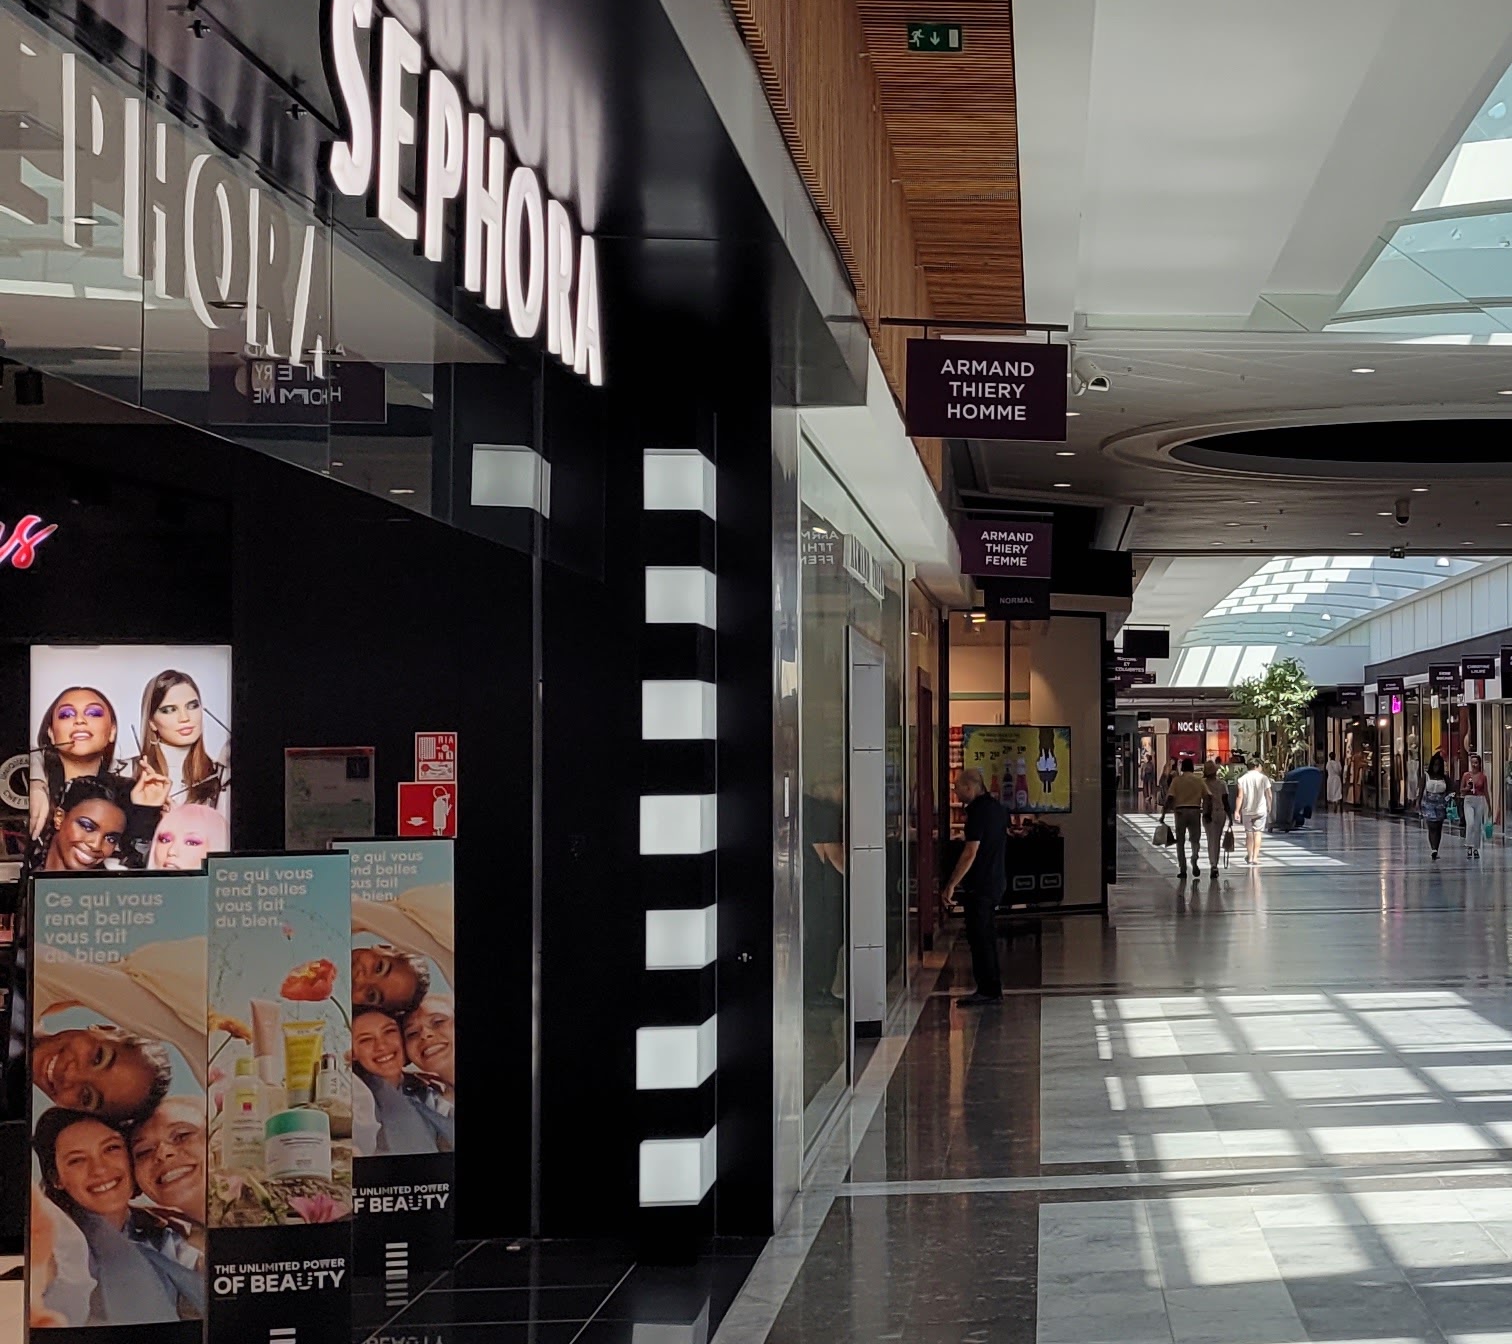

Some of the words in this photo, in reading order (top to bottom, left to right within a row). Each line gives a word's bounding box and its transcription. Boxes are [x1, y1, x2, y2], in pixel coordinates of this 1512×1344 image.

[940, 359, 1035, 377] ARMAND
[949, 381, 1026, 399] THIERY
[947, 403, 1027, 421] HOMME
[980, 531, 1035, 543] ARMAND
[985, 543, 1029, 555] THIERY
[985, 556, 1028, 567] FEMME
[999, 597, 1035, 605] NORMAL
[364, 850, 386, 864] qui
[391, 850, 424, 862] vous
[215, 868, 239, 883] Ce
[243, 867, 269, 885] qui
[275, 867, 314, 881] vous
[375, 862, 418, 876] belles
[215, 882, 251, 897] rend
[257, 881, 308, 896] belles
[376, 875, 399, 889] fait
[44, 892, 73, 908] Ce
[79, 891, 111, 910] qui
[116, 893, 164, 907] vous
[215, 898, 252, 913] vous
[257, 896, 286, 912] fait
[44, 909, 89, 927] rend
[95, 908, 156, 926] belles
[215, 913, 237, 929] du
[242, 913, 282, 928] bien.
[44, 930, 90, 946] vous
[95, 927, 128, 945] fait
[360, 1185, 412, 1196] UNLIMITED
[413, 1183, 450, 1194] POWER
[369, 1193, 450, 1213] BEAUTY
[214, 1264, 237, 1275] THE
[239, 1261, 301, 1274] UNLIMITED
[303, 1257, 346, 1271] POWER
[213, 1276, 245, 1295] OF
[250, 1269, 346, 1293] BEAUTY
